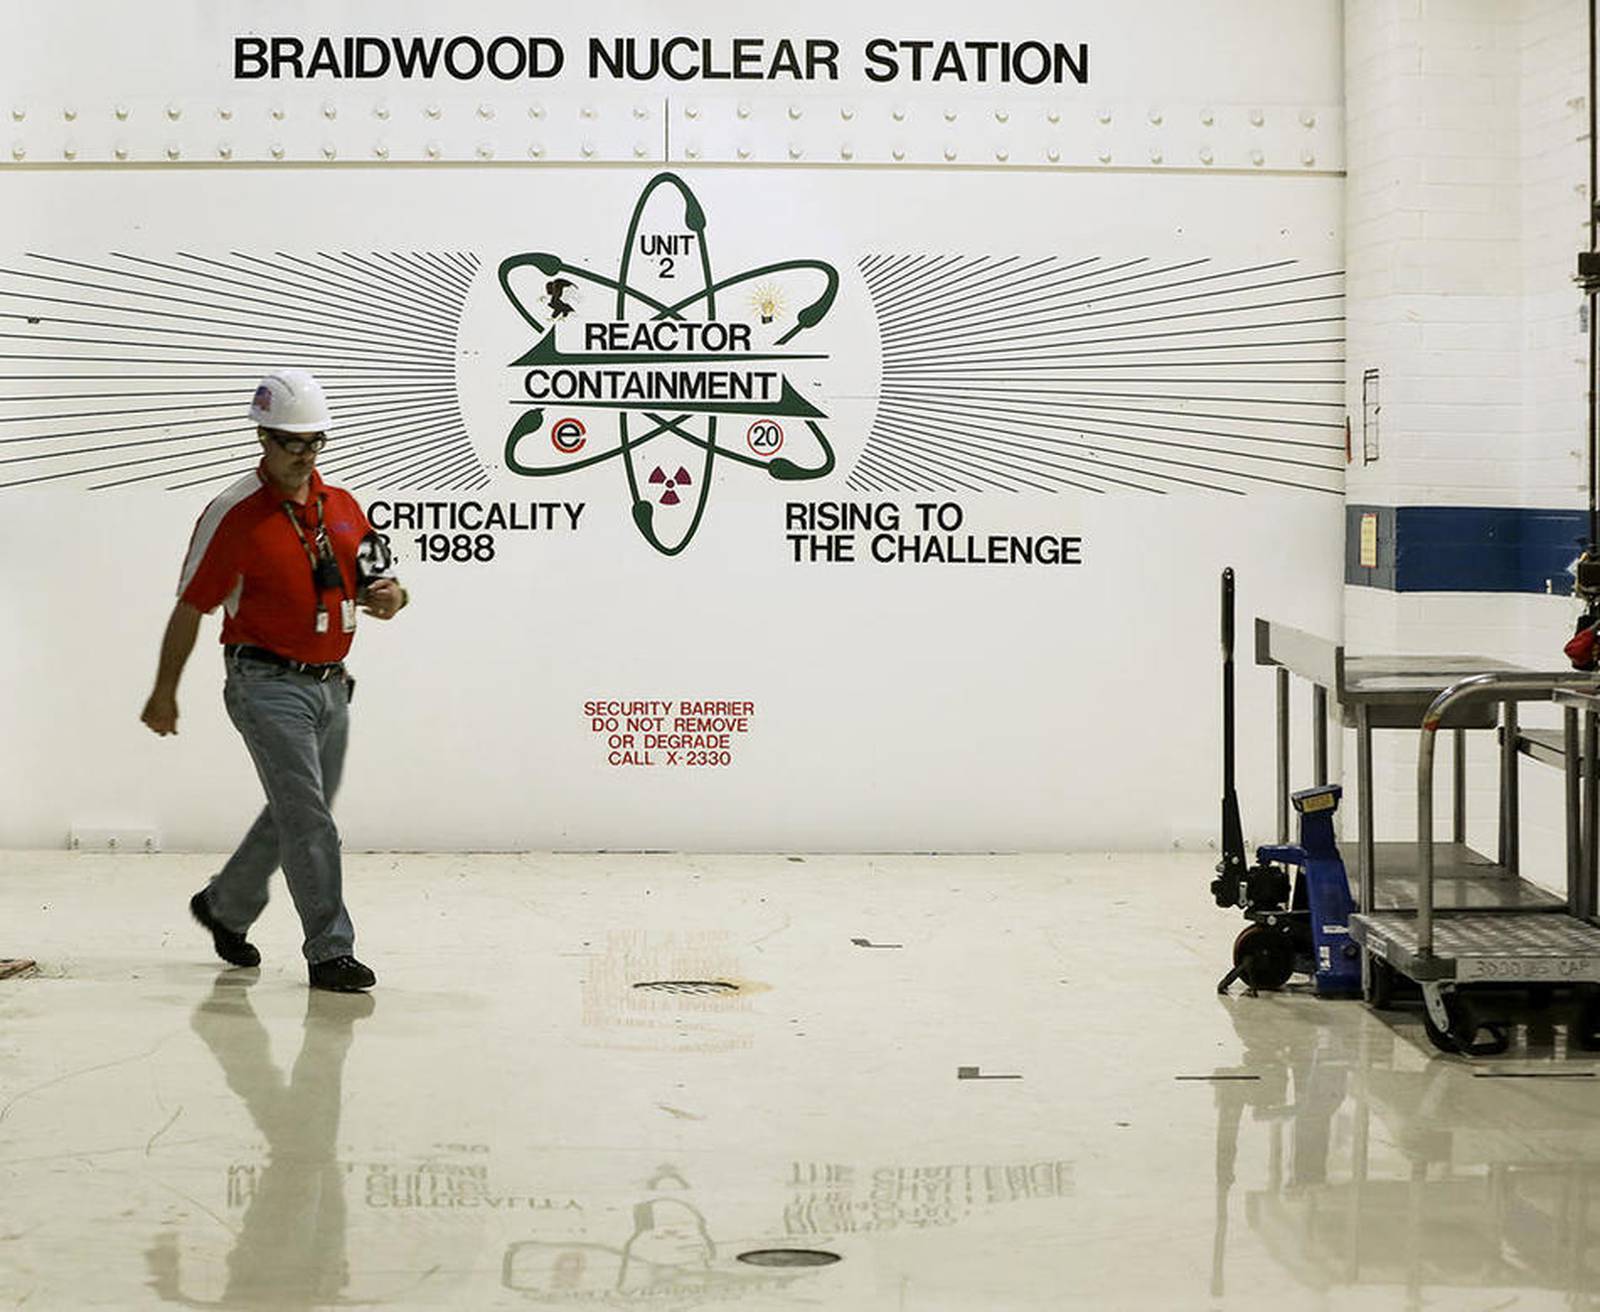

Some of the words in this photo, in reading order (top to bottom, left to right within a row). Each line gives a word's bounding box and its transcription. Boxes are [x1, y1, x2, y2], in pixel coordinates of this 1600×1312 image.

[235, 37, 564, 80] BRAIDWOOD
[589, 37, 839, 80] NUCLEAR
[865, 39, 1087, 84] STATION
[641, 235, 694, 255] UNIT
[659, 258, 674, 278] 2
[585, 322, 751, 352] REACTOR
[525, 369, 776, 402] CONTAINMENT
[752, 425, 779, 448] 20
[367, 501, 585, 530] CRITICALITY
[787, 502, 899, 531] RISING
[915, 502, 963, 531] TO
[414, 533, 495, 562] 1988
[787, 534, 854, 562] THE
[871, 534, 1081, 564] CHALLENGE
[584, 701, 672, 716] SECURITY
[680, 701, 754, 716] BARRIER
[592, 717, 619, 732] DO
[627, 717, 664, 732] NOT
[674, 717, 748, 732] REMOVE
[608, 734, 634, 749] OR
[644, 734, 730, 749] DEGRADE
[608, 751, 654, 766] CALL
[666, 751, 731, 766] X-2330
